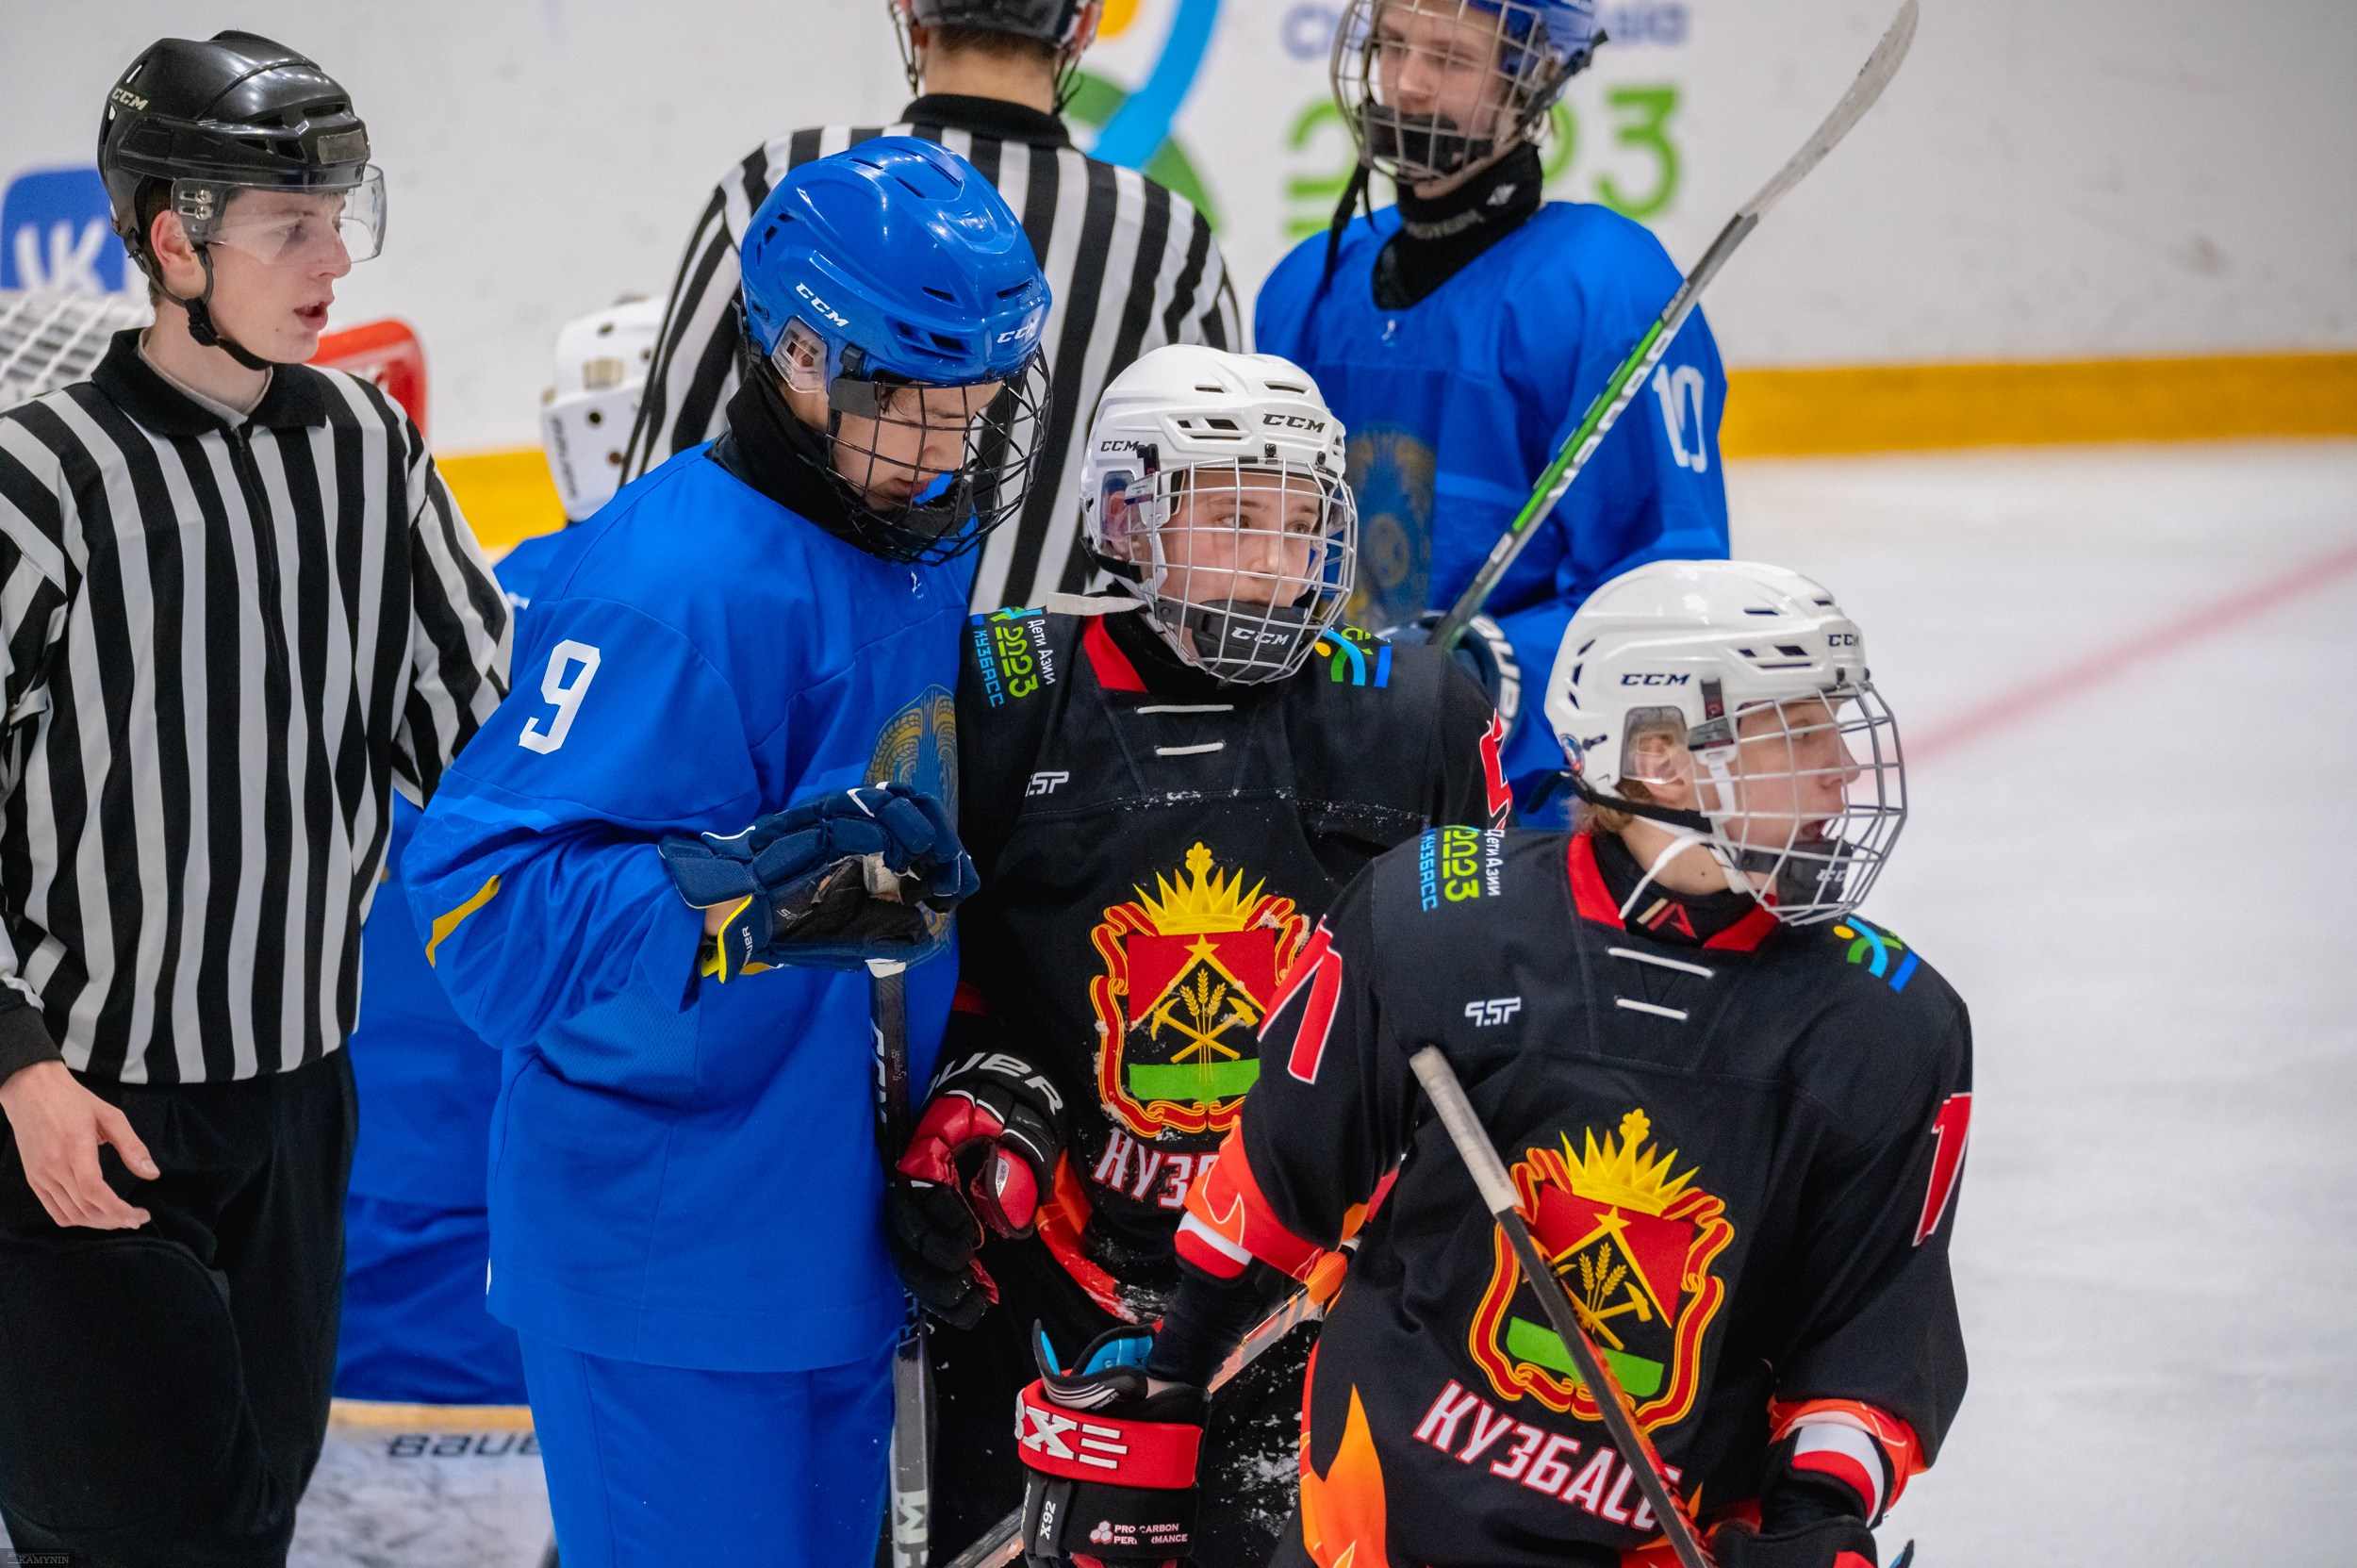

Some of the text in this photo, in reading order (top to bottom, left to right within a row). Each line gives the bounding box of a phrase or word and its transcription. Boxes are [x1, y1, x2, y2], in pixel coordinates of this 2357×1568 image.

[111, 87, 149, 111] CCM
[796, 281, 849, 327] CCM
[997, 318, 1039, 343] CCM
[1262, 413, 1326, 434] CCM
[1100, 440, 1140, 453] CCM
[1027, 619, 1056, 685] Дети Азии
[1231, 626, 1290, 646] CCM
[1827, 633, 1860, 648] CCM
[974, 630, 1005, 708] КУЗБАСС
[995, 626, 1039, 698] 2023
[1620, 673, 1691, 686] CCM
[519, 639, 601, 754] 9
[1484, 829, 1506, 856] Дети
[1420, 834, 1439, 912] КУЗБАСС
[1442, 830, 1480, 902] 2023
[1485, 858, 1505, 897] Азии
[740, 926, 752, 965] UER
[1014, 1387, 1129, 1470] XE
[1039, 1500, 1057, 1541] X92
[1113, 1523, 1179, 1534] PRO CARBON
[1113, 1534, 1188, 1545] PERMANCE
